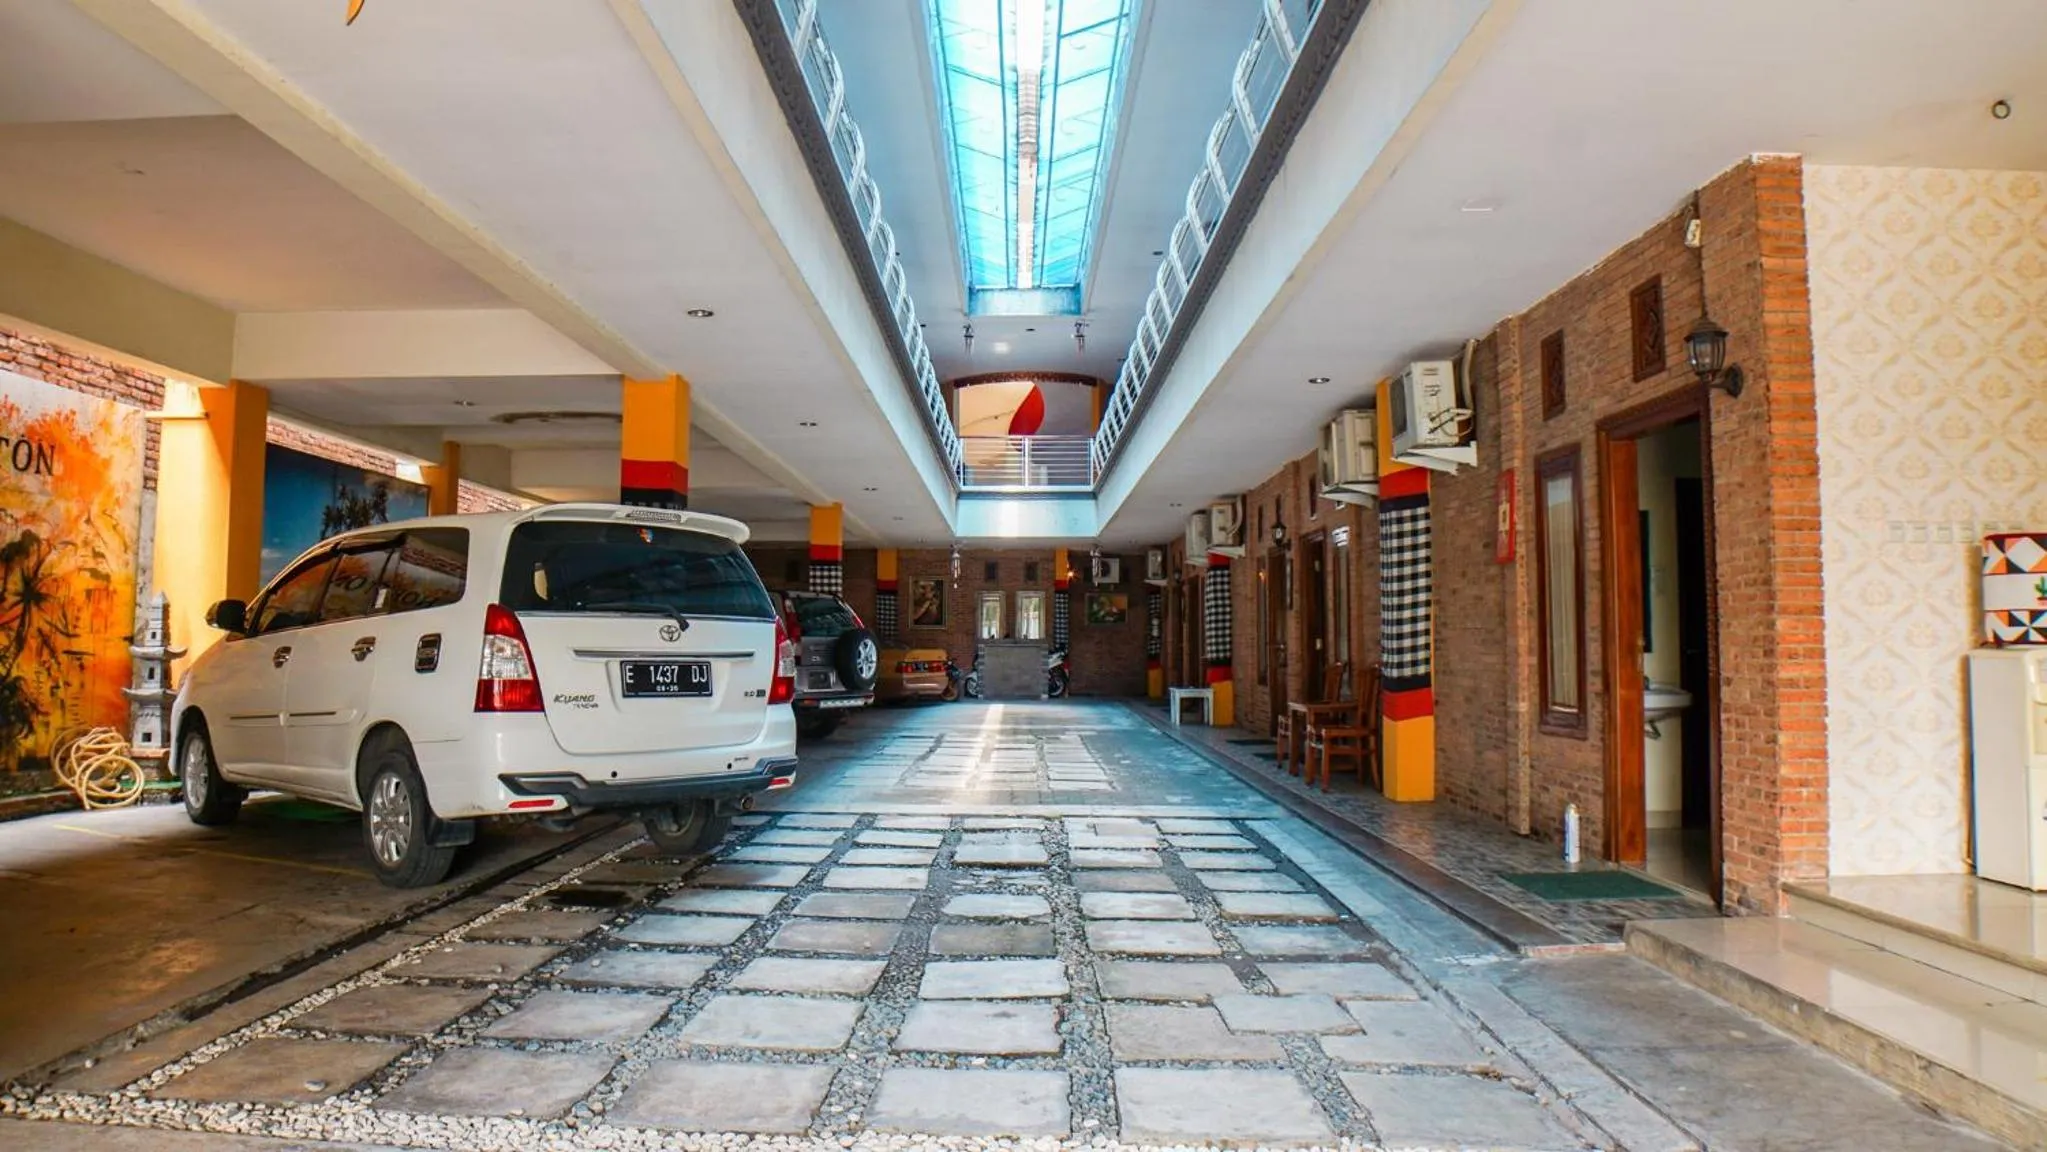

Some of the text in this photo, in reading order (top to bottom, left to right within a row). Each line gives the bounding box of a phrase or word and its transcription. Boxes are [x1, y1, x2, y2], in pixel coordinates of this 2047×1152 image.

[625, 665, 707, 684] E 1437 DJ
